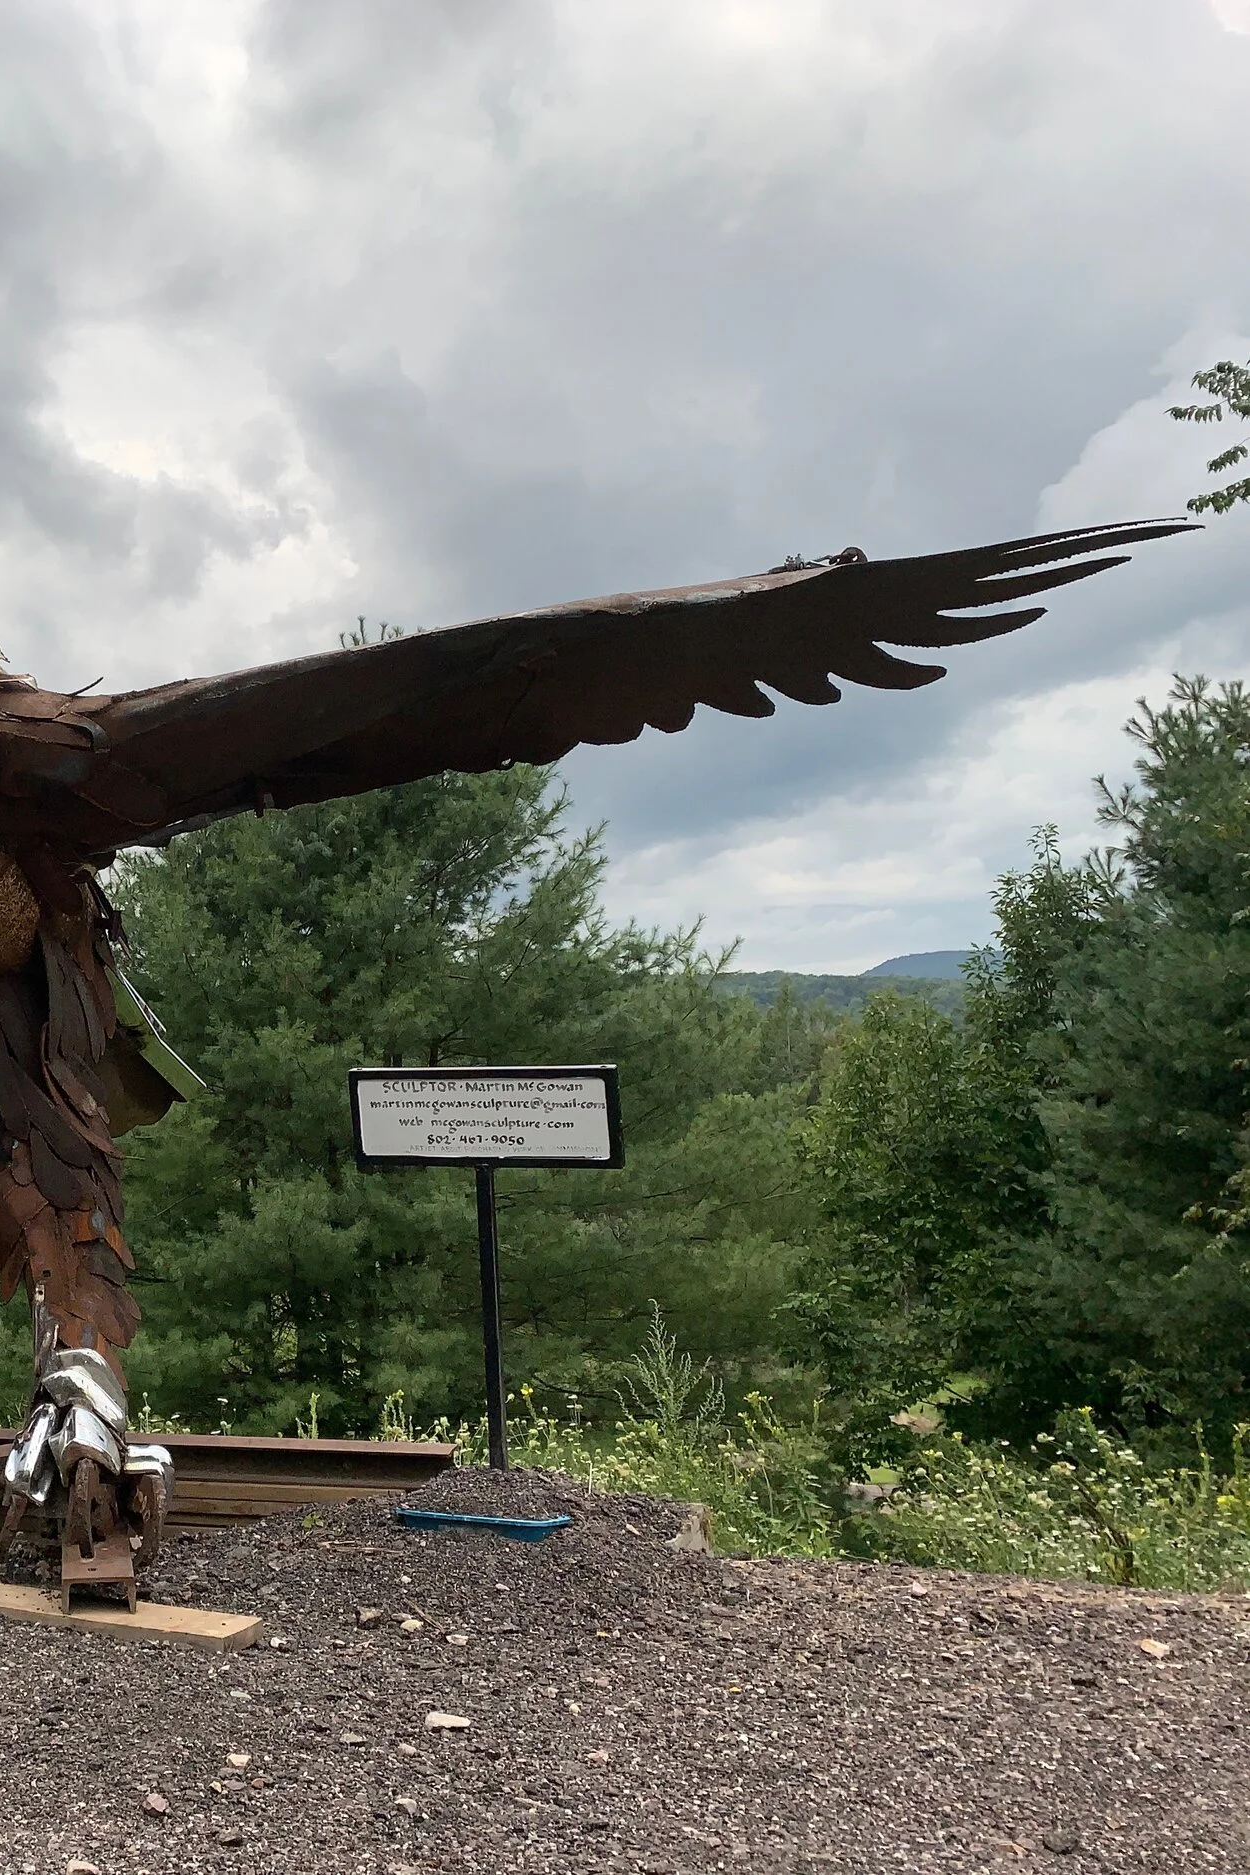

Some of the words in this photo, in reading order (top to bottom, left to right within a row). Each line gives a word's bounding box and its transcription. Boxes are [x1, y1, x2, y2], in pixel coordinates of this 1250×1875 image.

[382, 1081, 457, 1094] SCULPTOR
[465, 1081, 515, 1093] Martin
[398, 1116, 424, 1127] web
